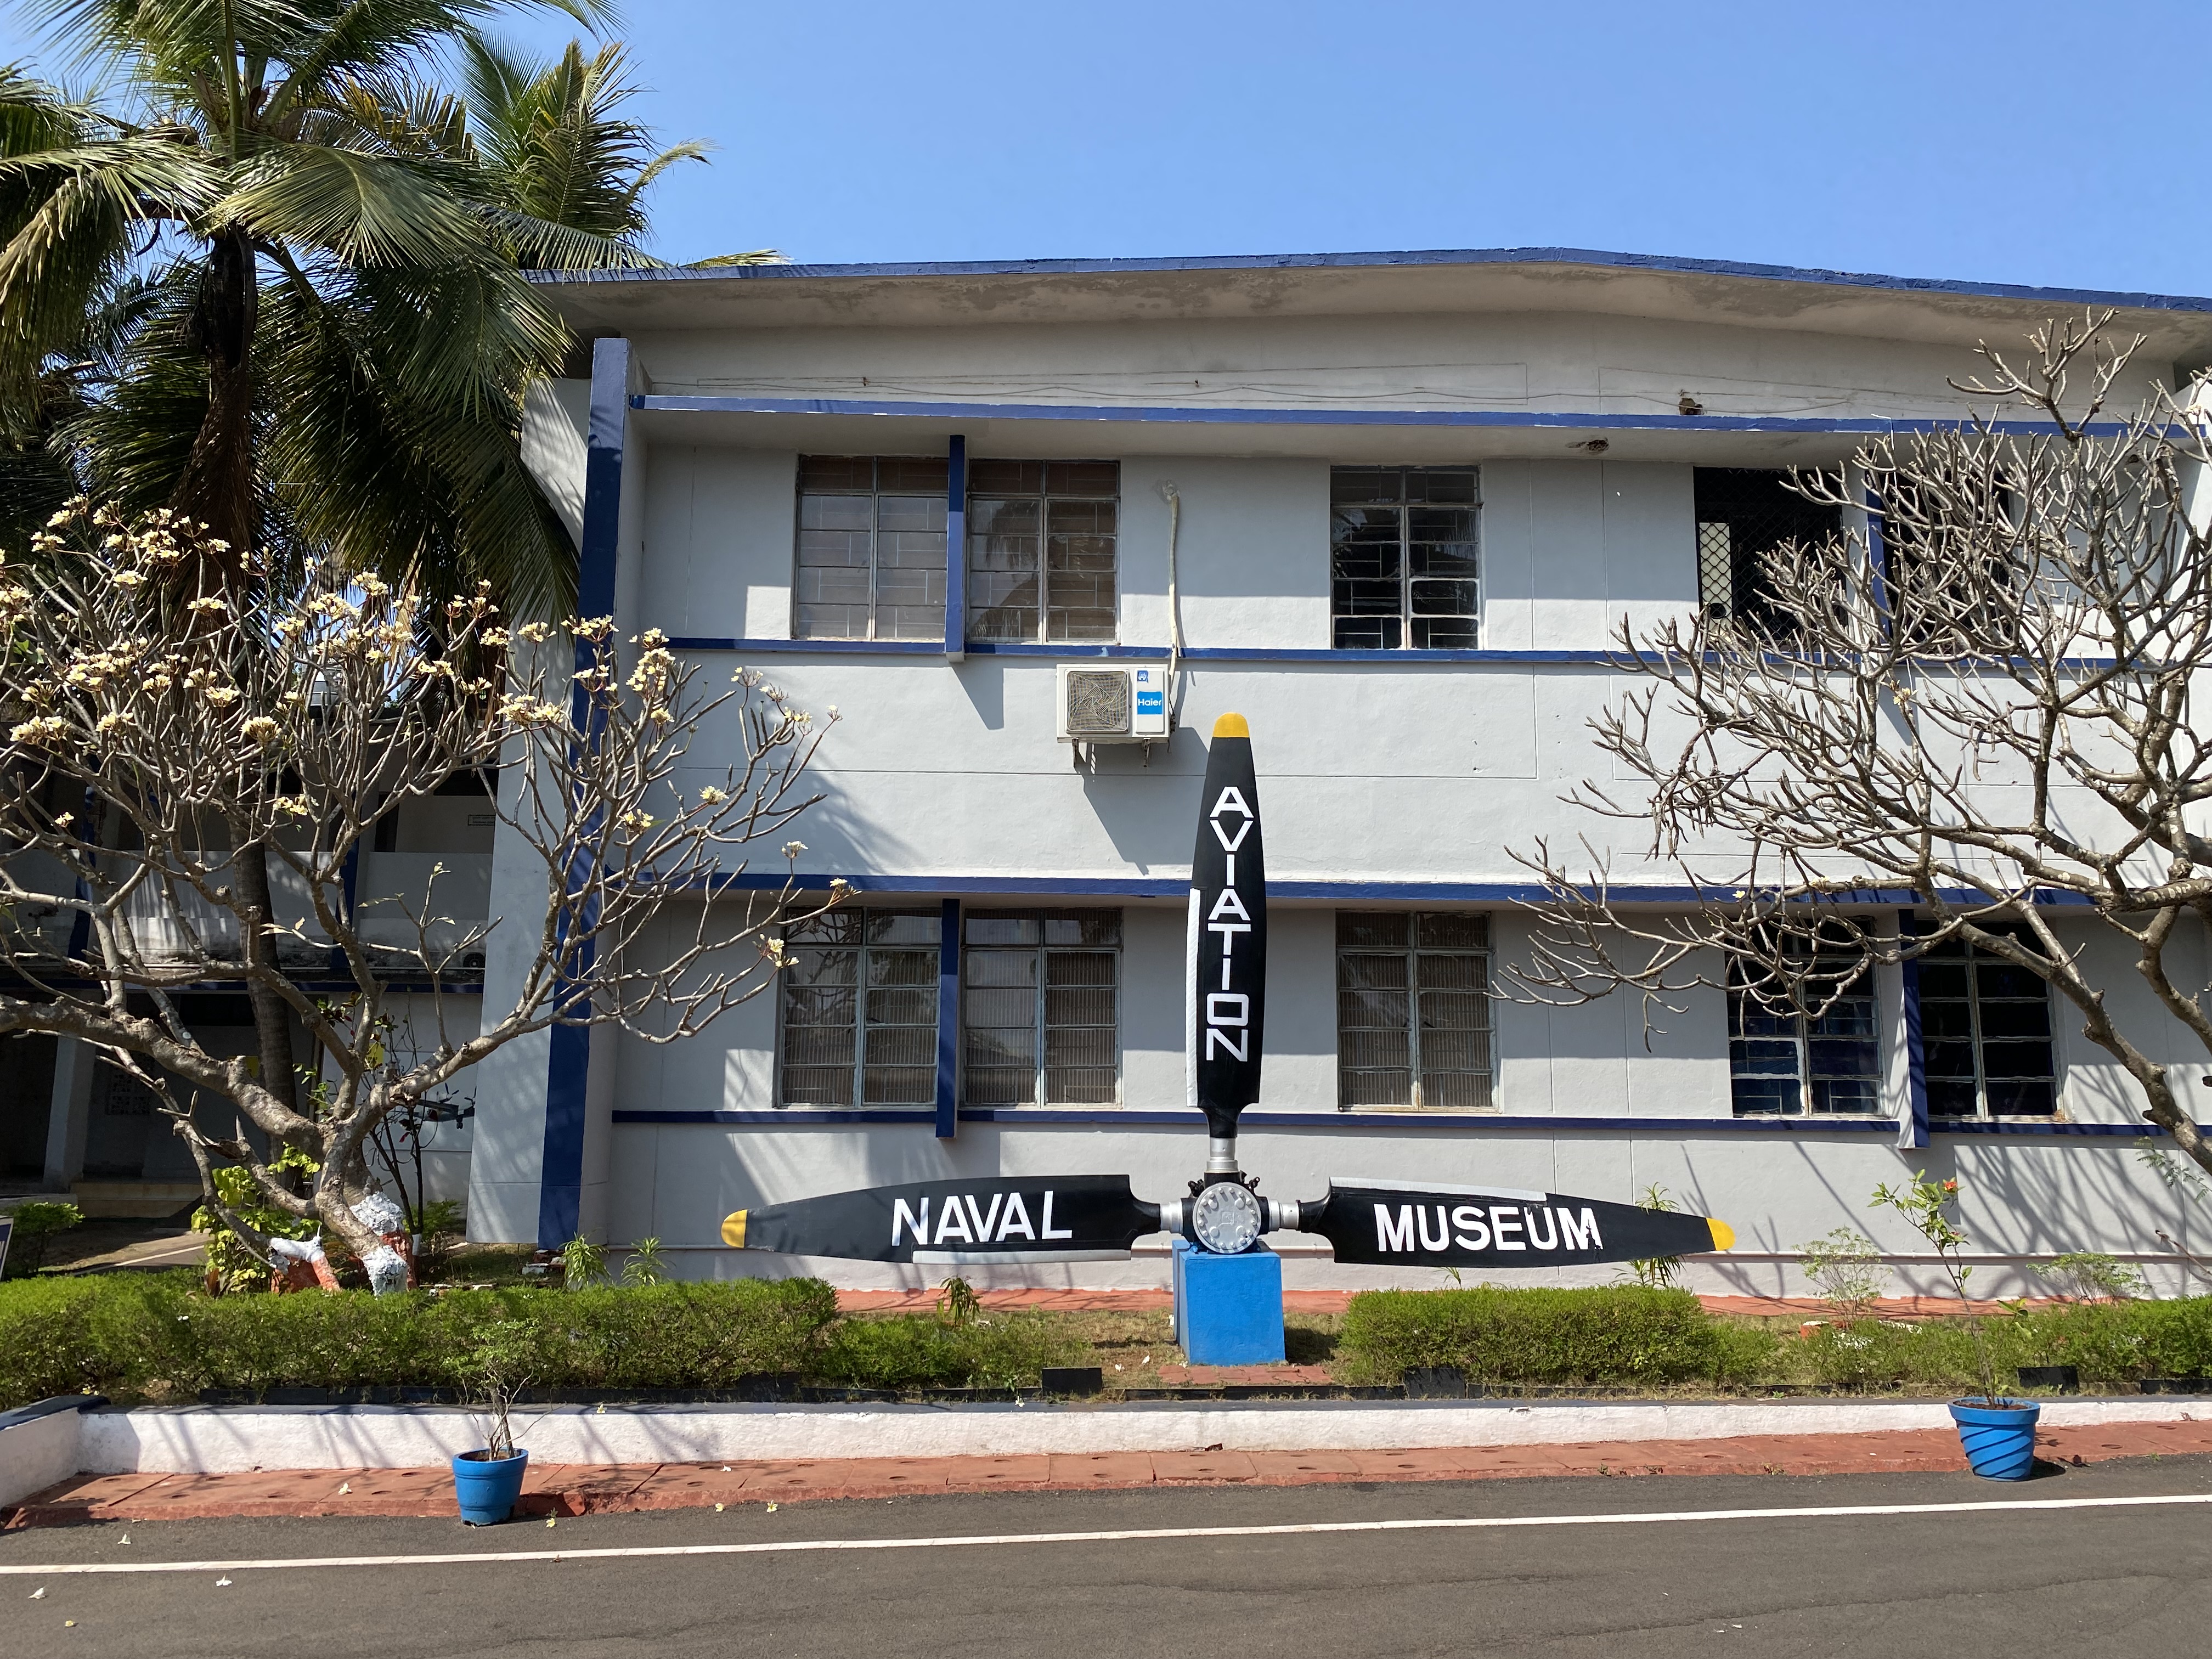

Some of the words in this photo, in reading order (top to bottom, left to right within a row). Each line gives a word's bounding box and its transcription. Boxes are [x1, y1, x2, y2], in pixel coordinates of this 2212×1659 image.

[1206, 786, 1254, 1062] AVIATION
[891, 1190, 1073, 1246] NAVAL
[1373, 1204, 1604, 1252] MUSEUM
